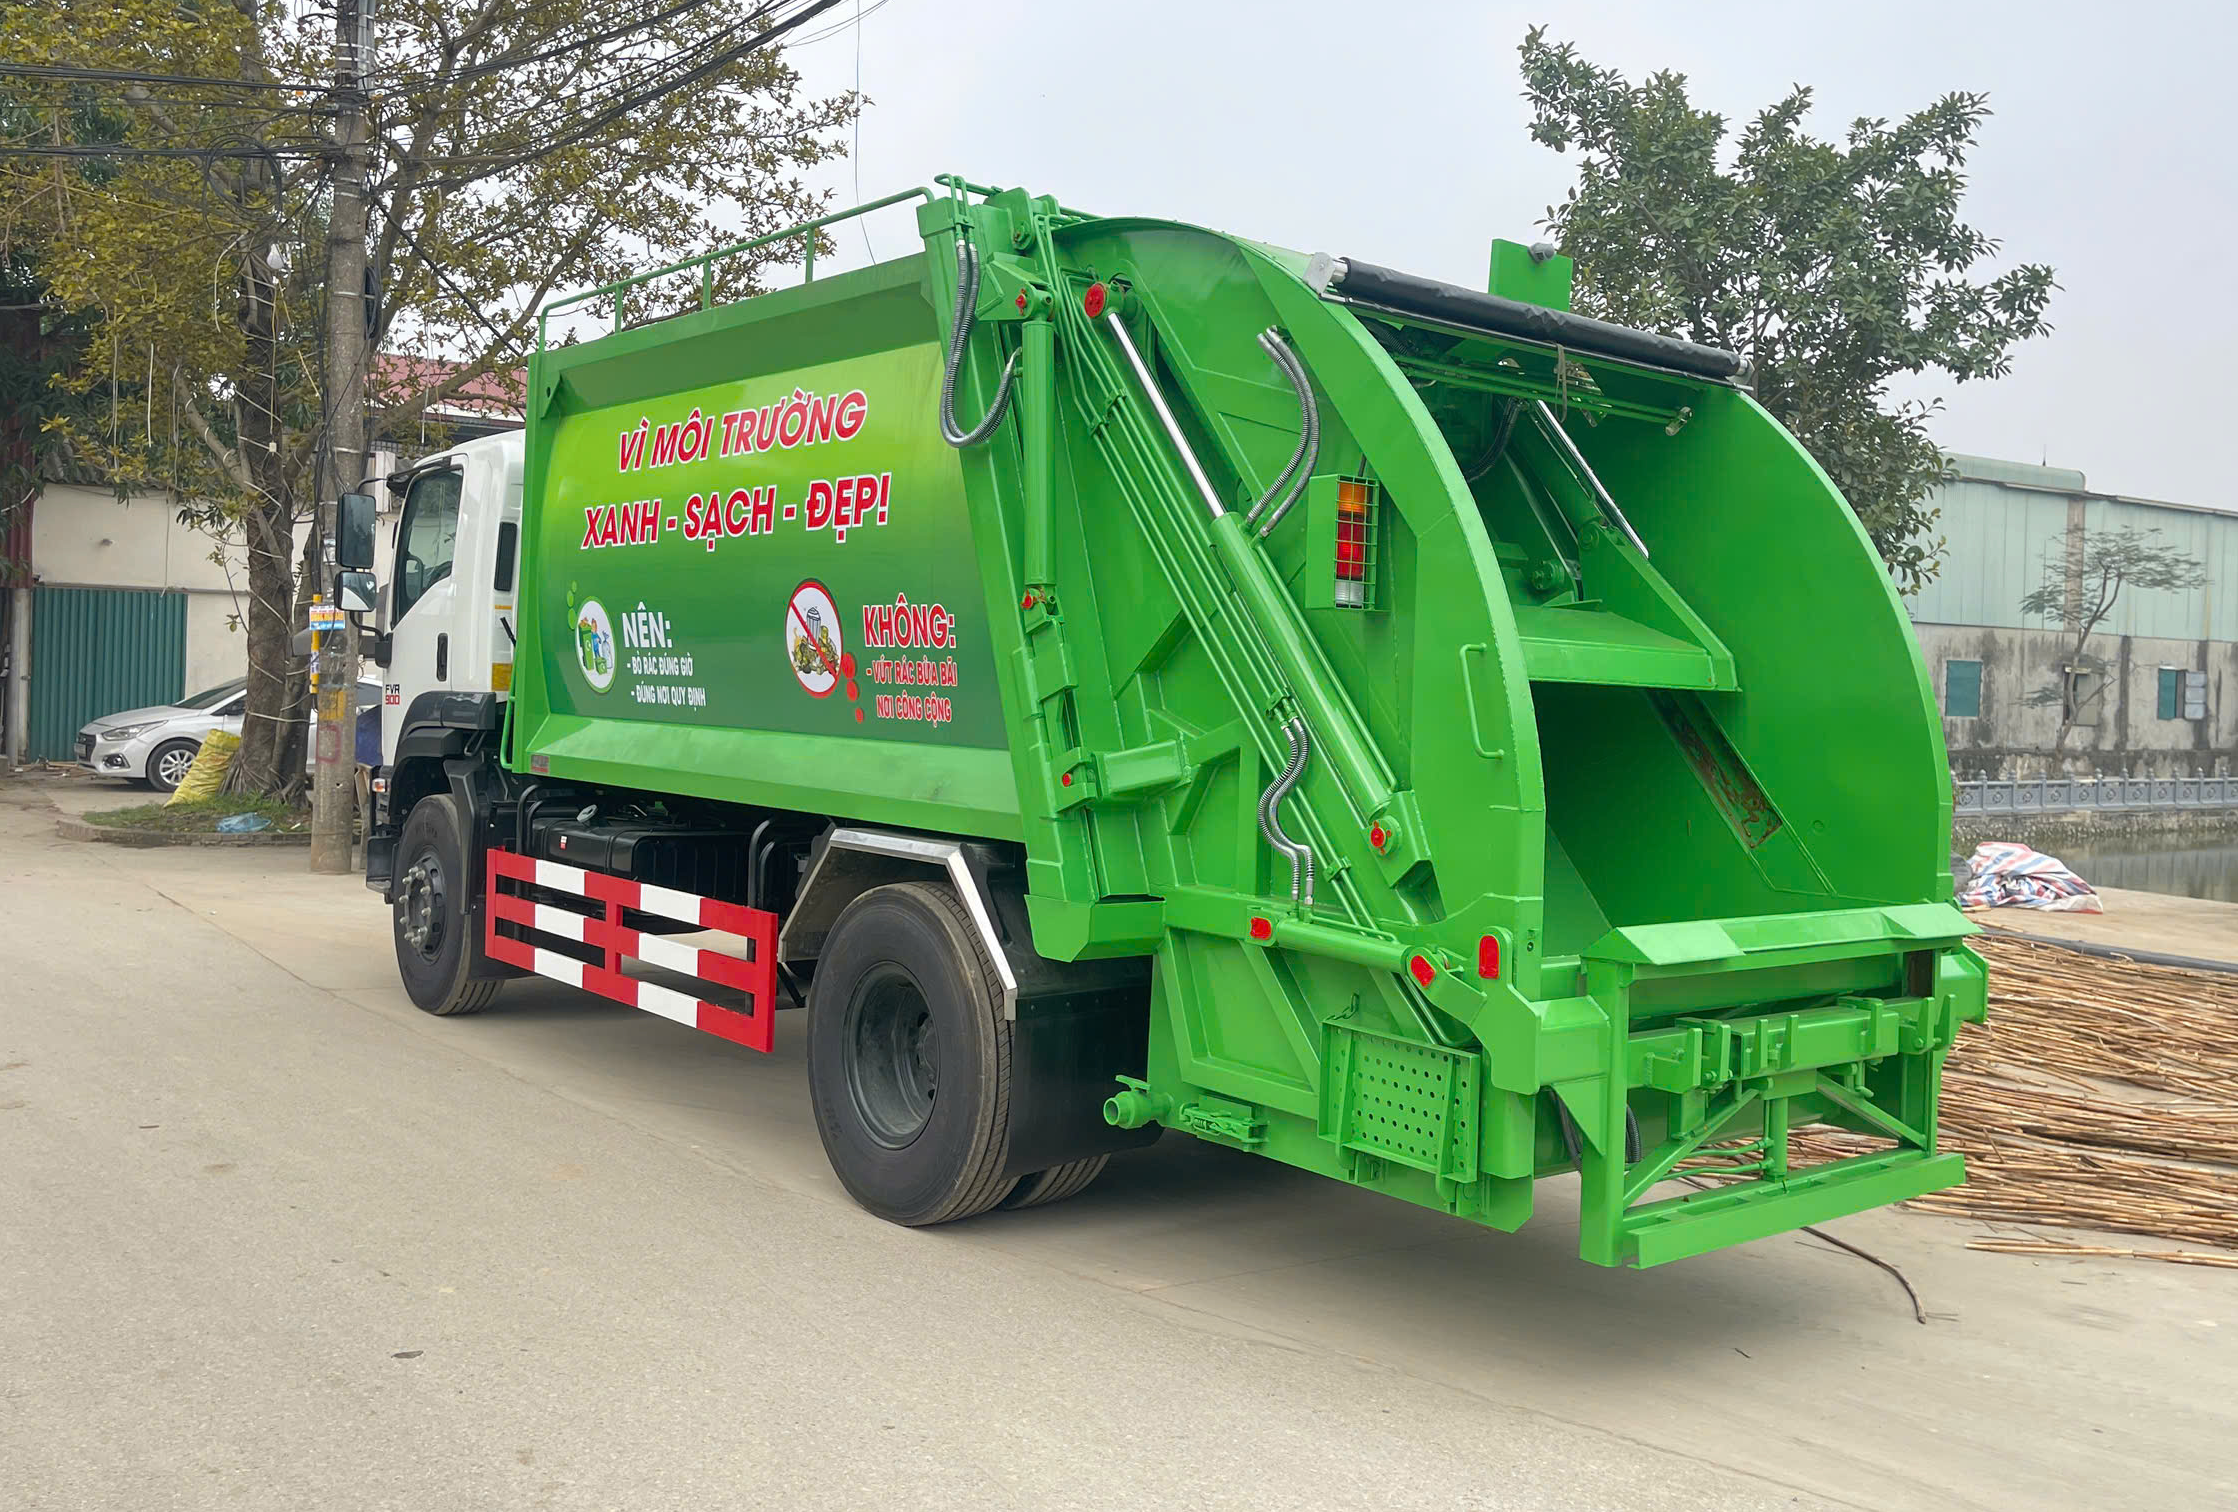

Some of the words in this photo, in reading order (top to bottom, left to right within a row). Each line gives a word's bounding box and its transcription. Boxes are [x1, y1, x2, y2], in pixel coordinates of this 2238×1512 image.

[619, 415, 649, 473] VÌ
[650, 407, 715, 469] MÔI
[720, 387, 867, 458] TRƯỜNG
[580, 498, 662, 550] XANH
[683, 484, 778, 552] SẠCH
[805, 472, 892, 543] ĐẸP!
[622, 601, 672, 648] NÊN:
[863, 592, 956, 649] KHÔNG:
[643, 652, 658, 675] RÁC
[659, 652, 679, 676] ĐÚNG
[680, 652, 694, 677] GIỜ
[894, 654, 915, 685] RÁC
[940, 656, 957, 687] BÃI
[385, 695, 400, 705] 900
[636, 680, 656, 703] ĐÚNG
[656, 685, 670, 705] NƠI
[671, 686, 686, 707] QUY
[688, 687, 707, 712] ĐỊNH
[876, 694, 894, 719] NƠI
[895, 689, 922, 720] CÔNG
[924, 691, 952, 728] CỘNG
